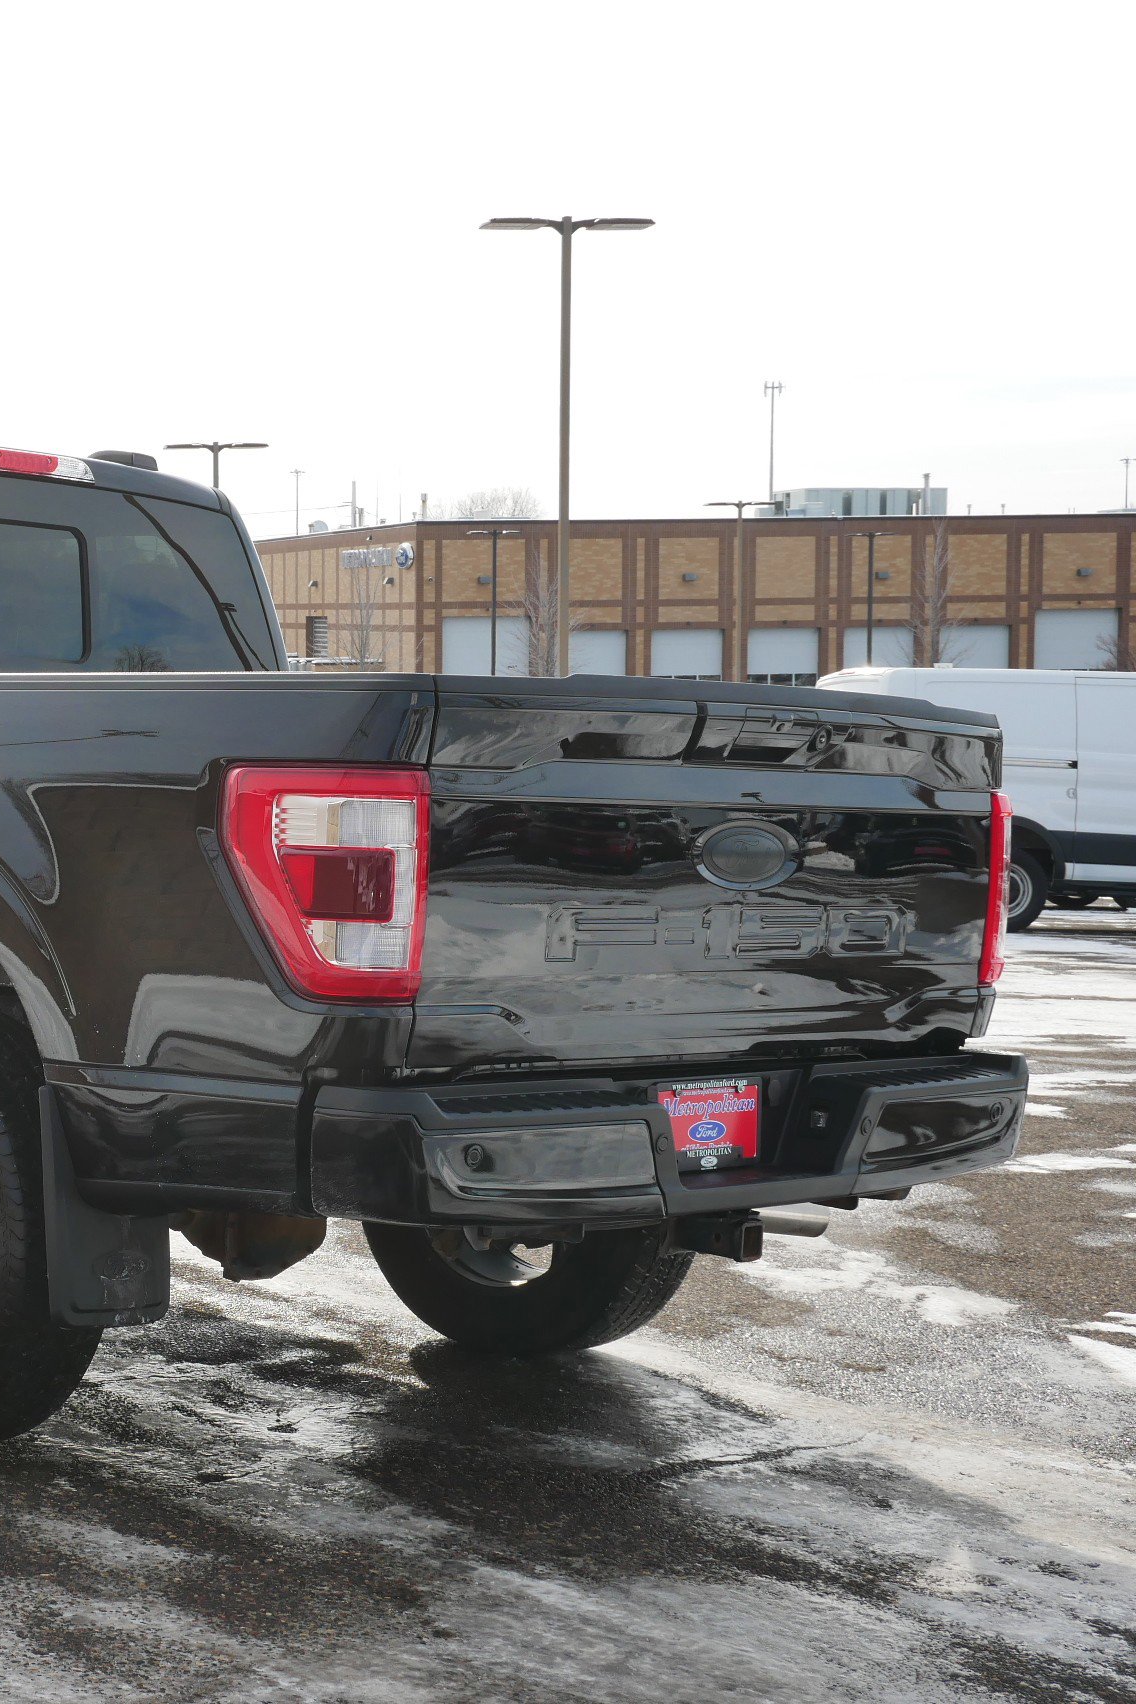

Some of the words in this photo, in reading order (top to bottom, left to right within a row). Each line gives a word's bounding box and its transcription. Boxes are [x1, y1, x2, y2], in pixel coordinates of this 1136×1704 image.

[544, 904, 908, 963] F-150
[672, 1079, 747, 1090] www.metropolitanford.com
[663, 1094, 755, 1120] Metropolitan
[696, 1125, 718, 1138] Ford
[687, 1148, 732, 1157] METROPOLITAN
